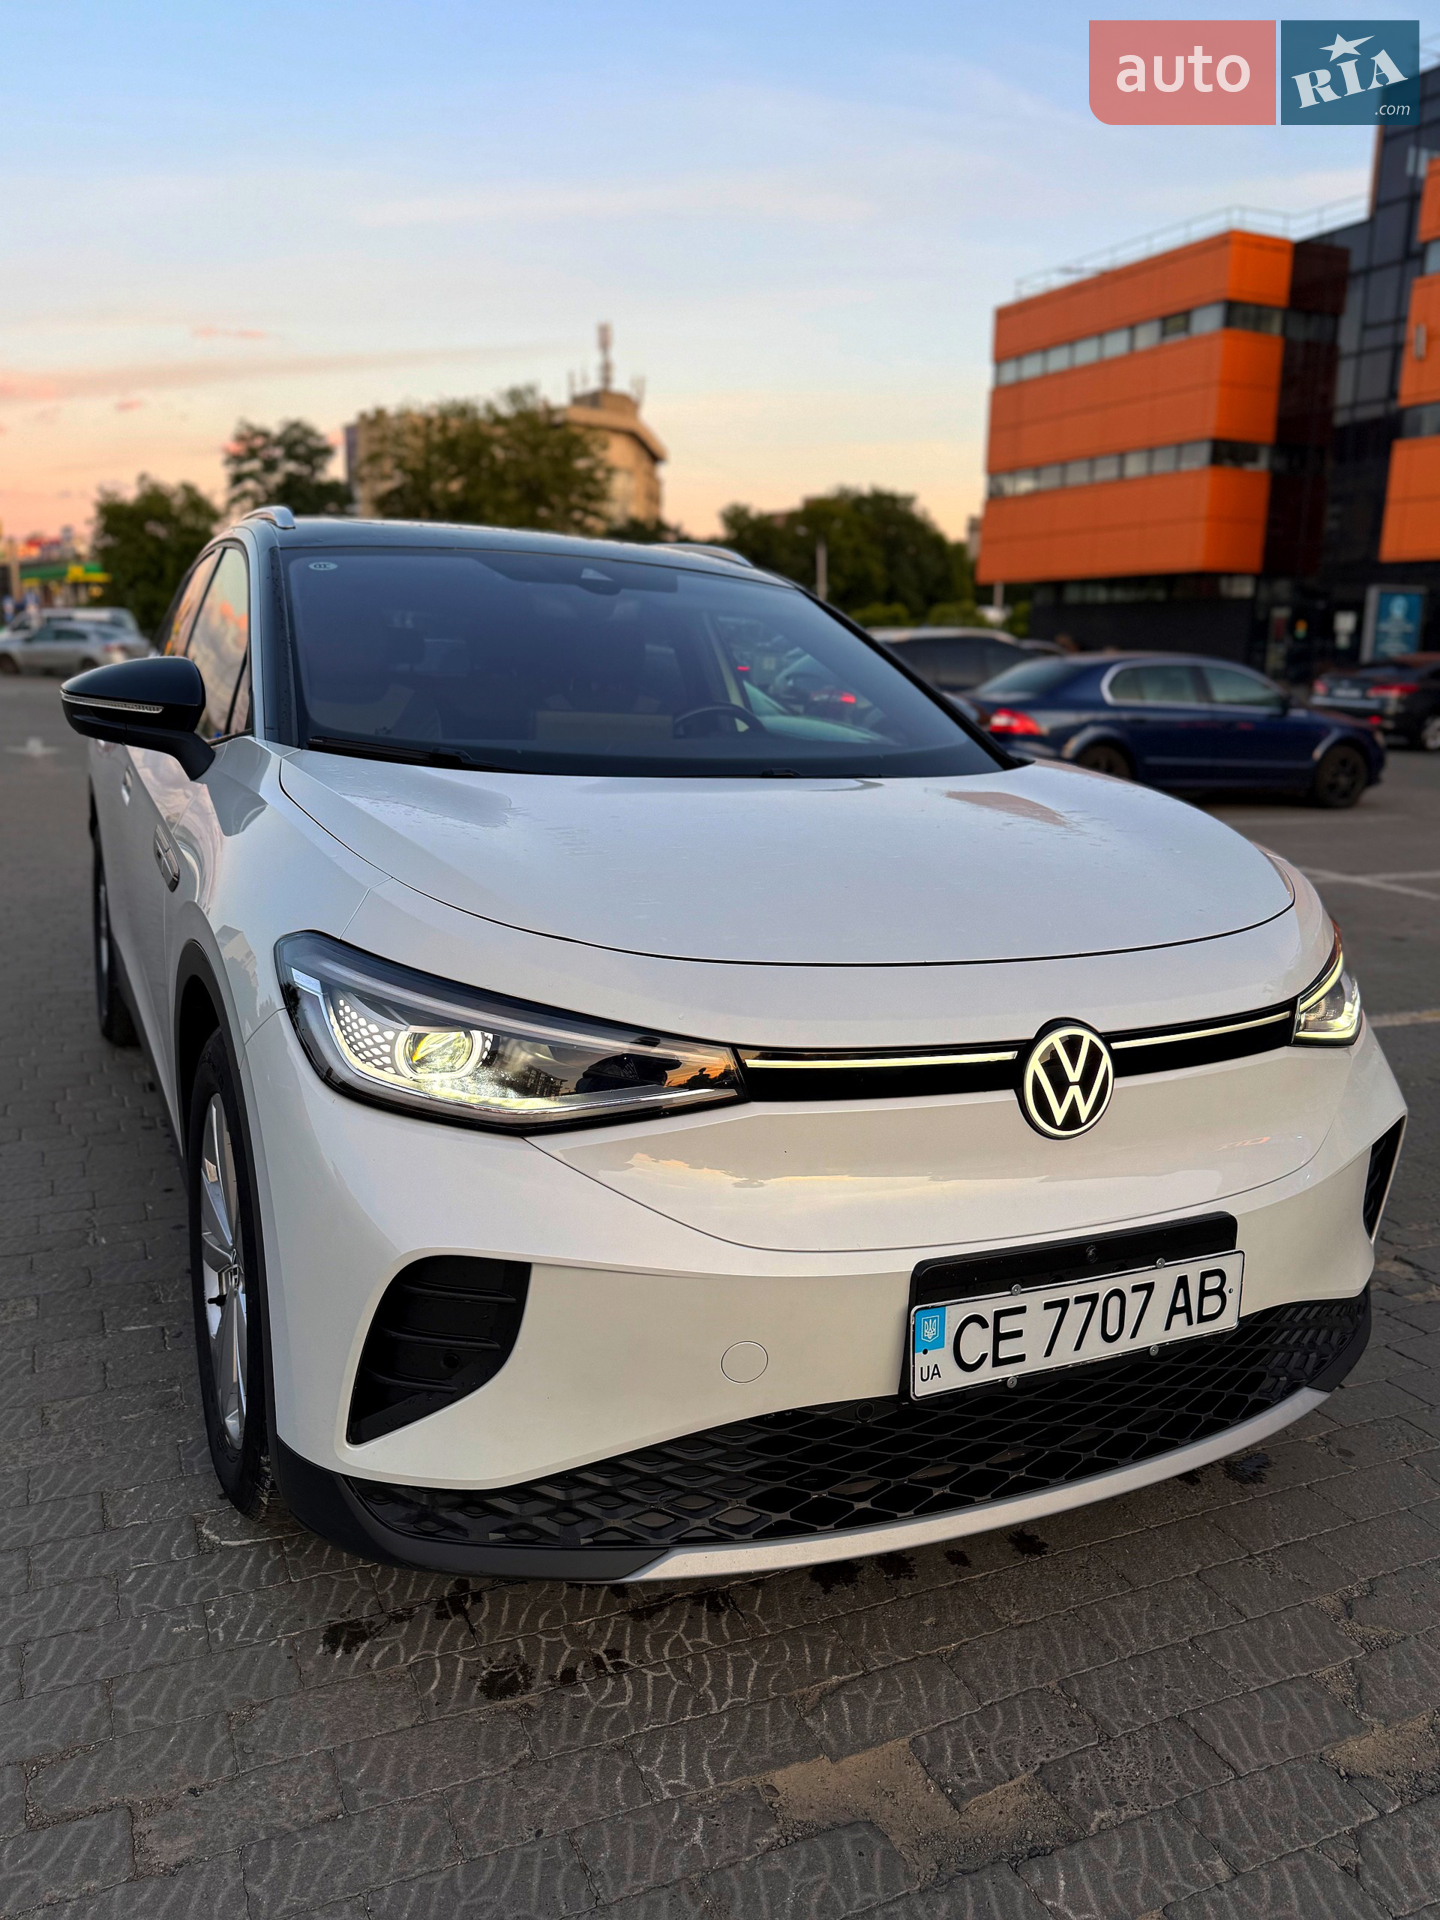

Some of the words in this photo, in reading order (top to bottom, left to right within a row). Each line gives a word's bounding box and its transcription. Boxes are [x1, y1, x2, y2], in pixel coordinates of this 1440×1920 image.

[952, 1305, 1027, 1373] CE
[1043, 1280, 1156, 1358] 7707
[1164, 1267, 1228, 1332] AB
[919, 1363, 942, 1382] UA
